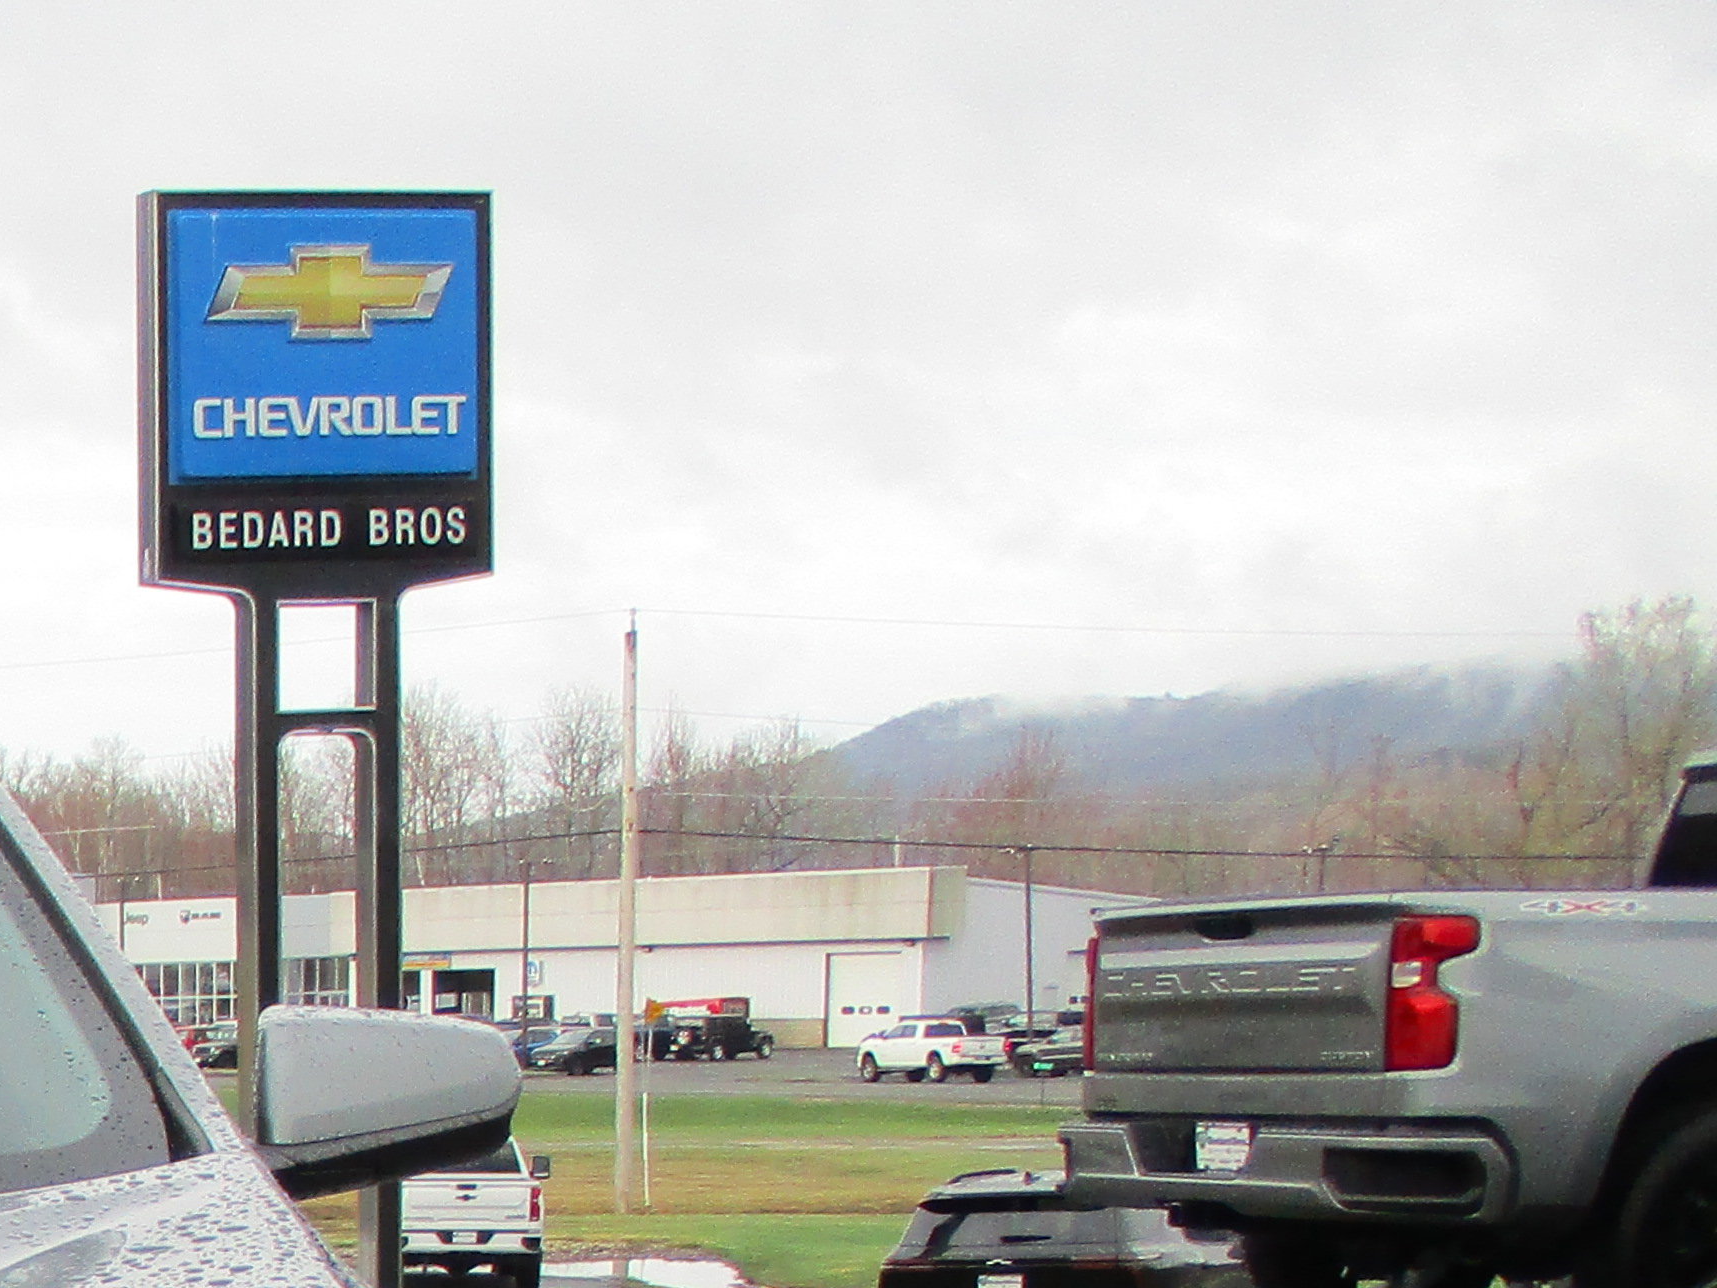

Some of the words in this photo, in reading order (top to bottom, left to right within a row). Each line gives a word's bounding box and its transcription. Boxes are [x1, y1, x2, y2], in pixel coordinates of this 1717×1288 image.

[193, 396, 466, 440] CHEVROLET
[192, 510, 342, 550] BEDARD
[369, 507, 466, 546] BROS
[1102, 965, 1357, 998] CHEVROLET
